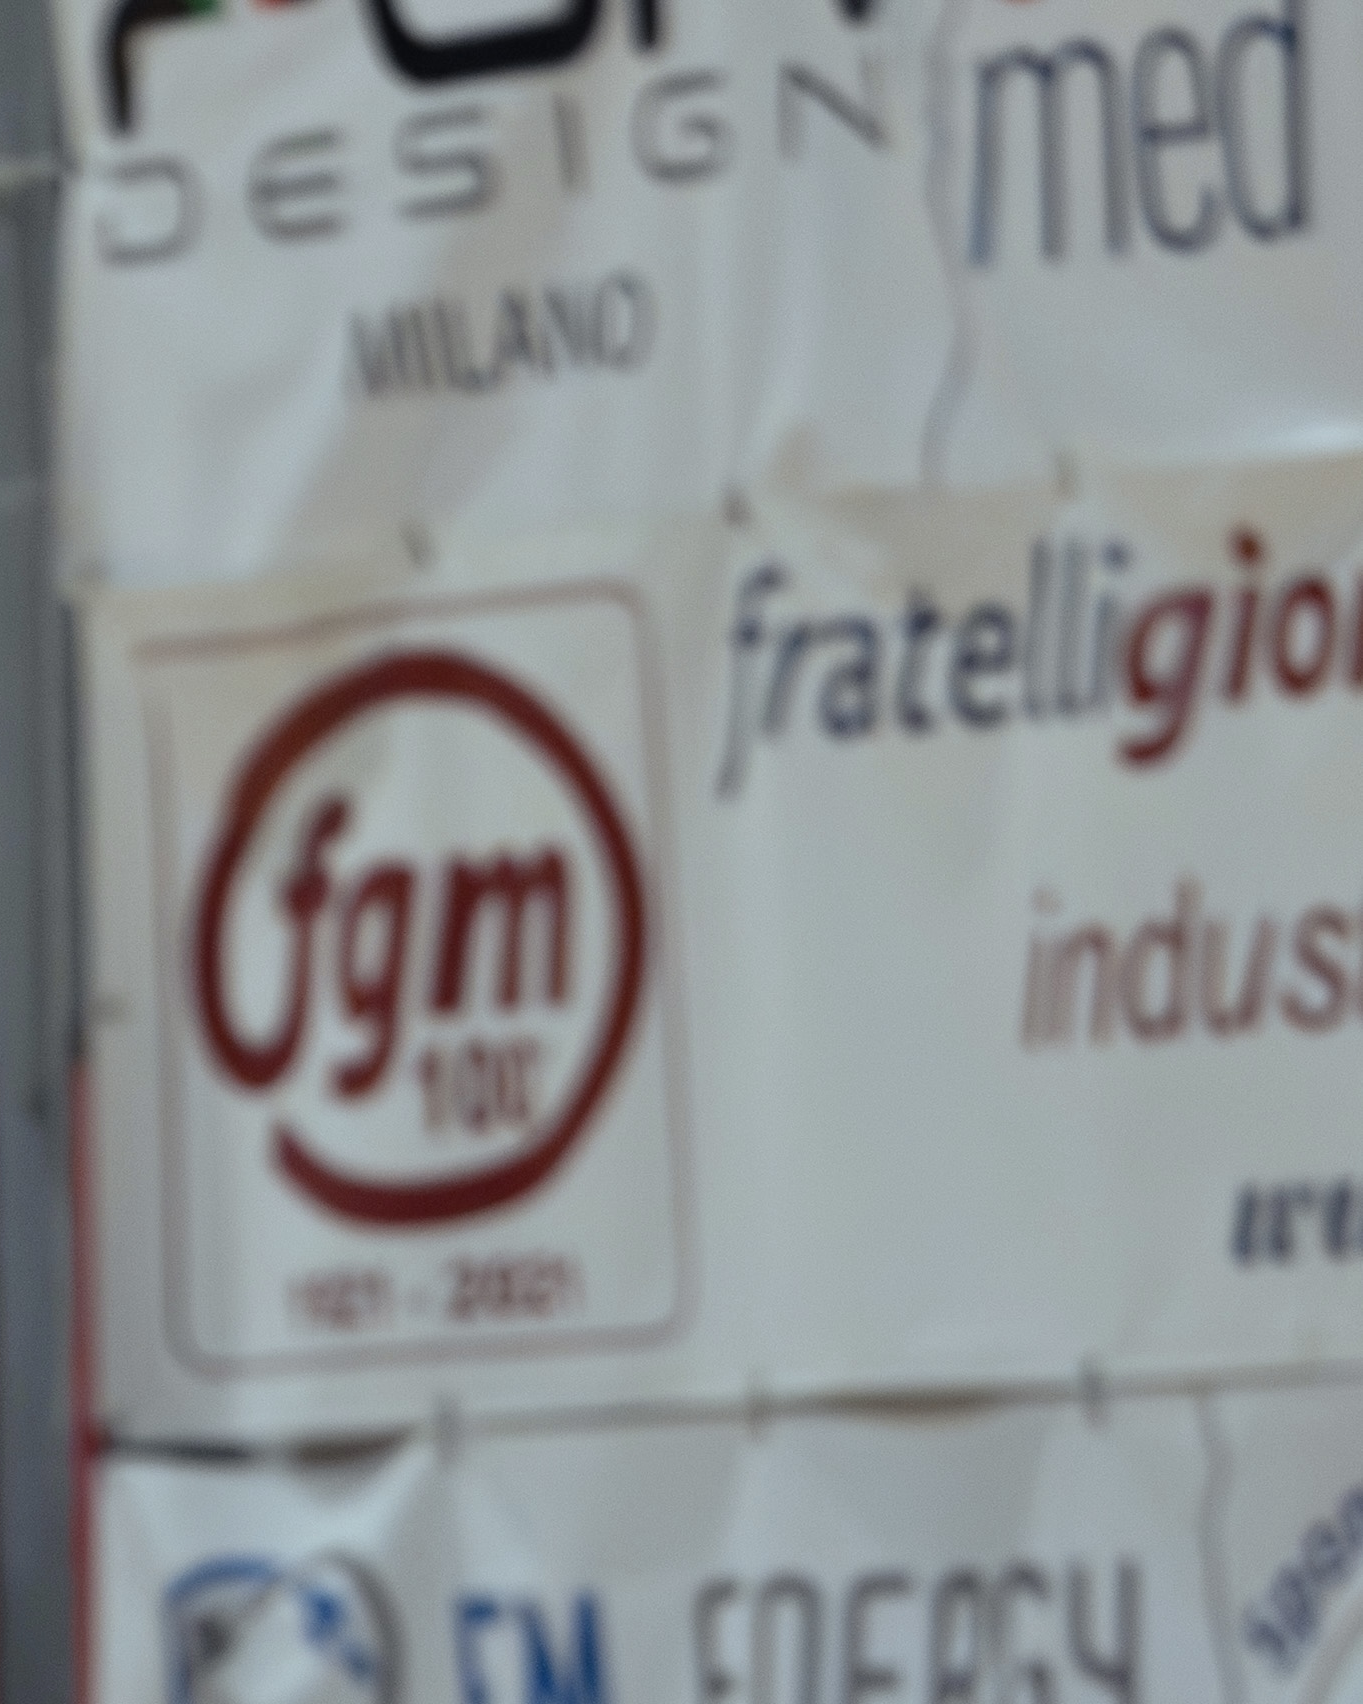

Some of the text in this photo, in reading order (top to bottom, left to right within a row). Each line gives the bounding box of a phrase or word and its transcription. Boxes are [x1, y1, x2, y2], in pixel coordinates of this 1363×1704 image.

[91, 58, 895, 268] DESIGN
[349, 270, 659, 398] MILANO
[271, 785, 575, 1106] fgm
[1015, 870, 1363, 1054] indus
